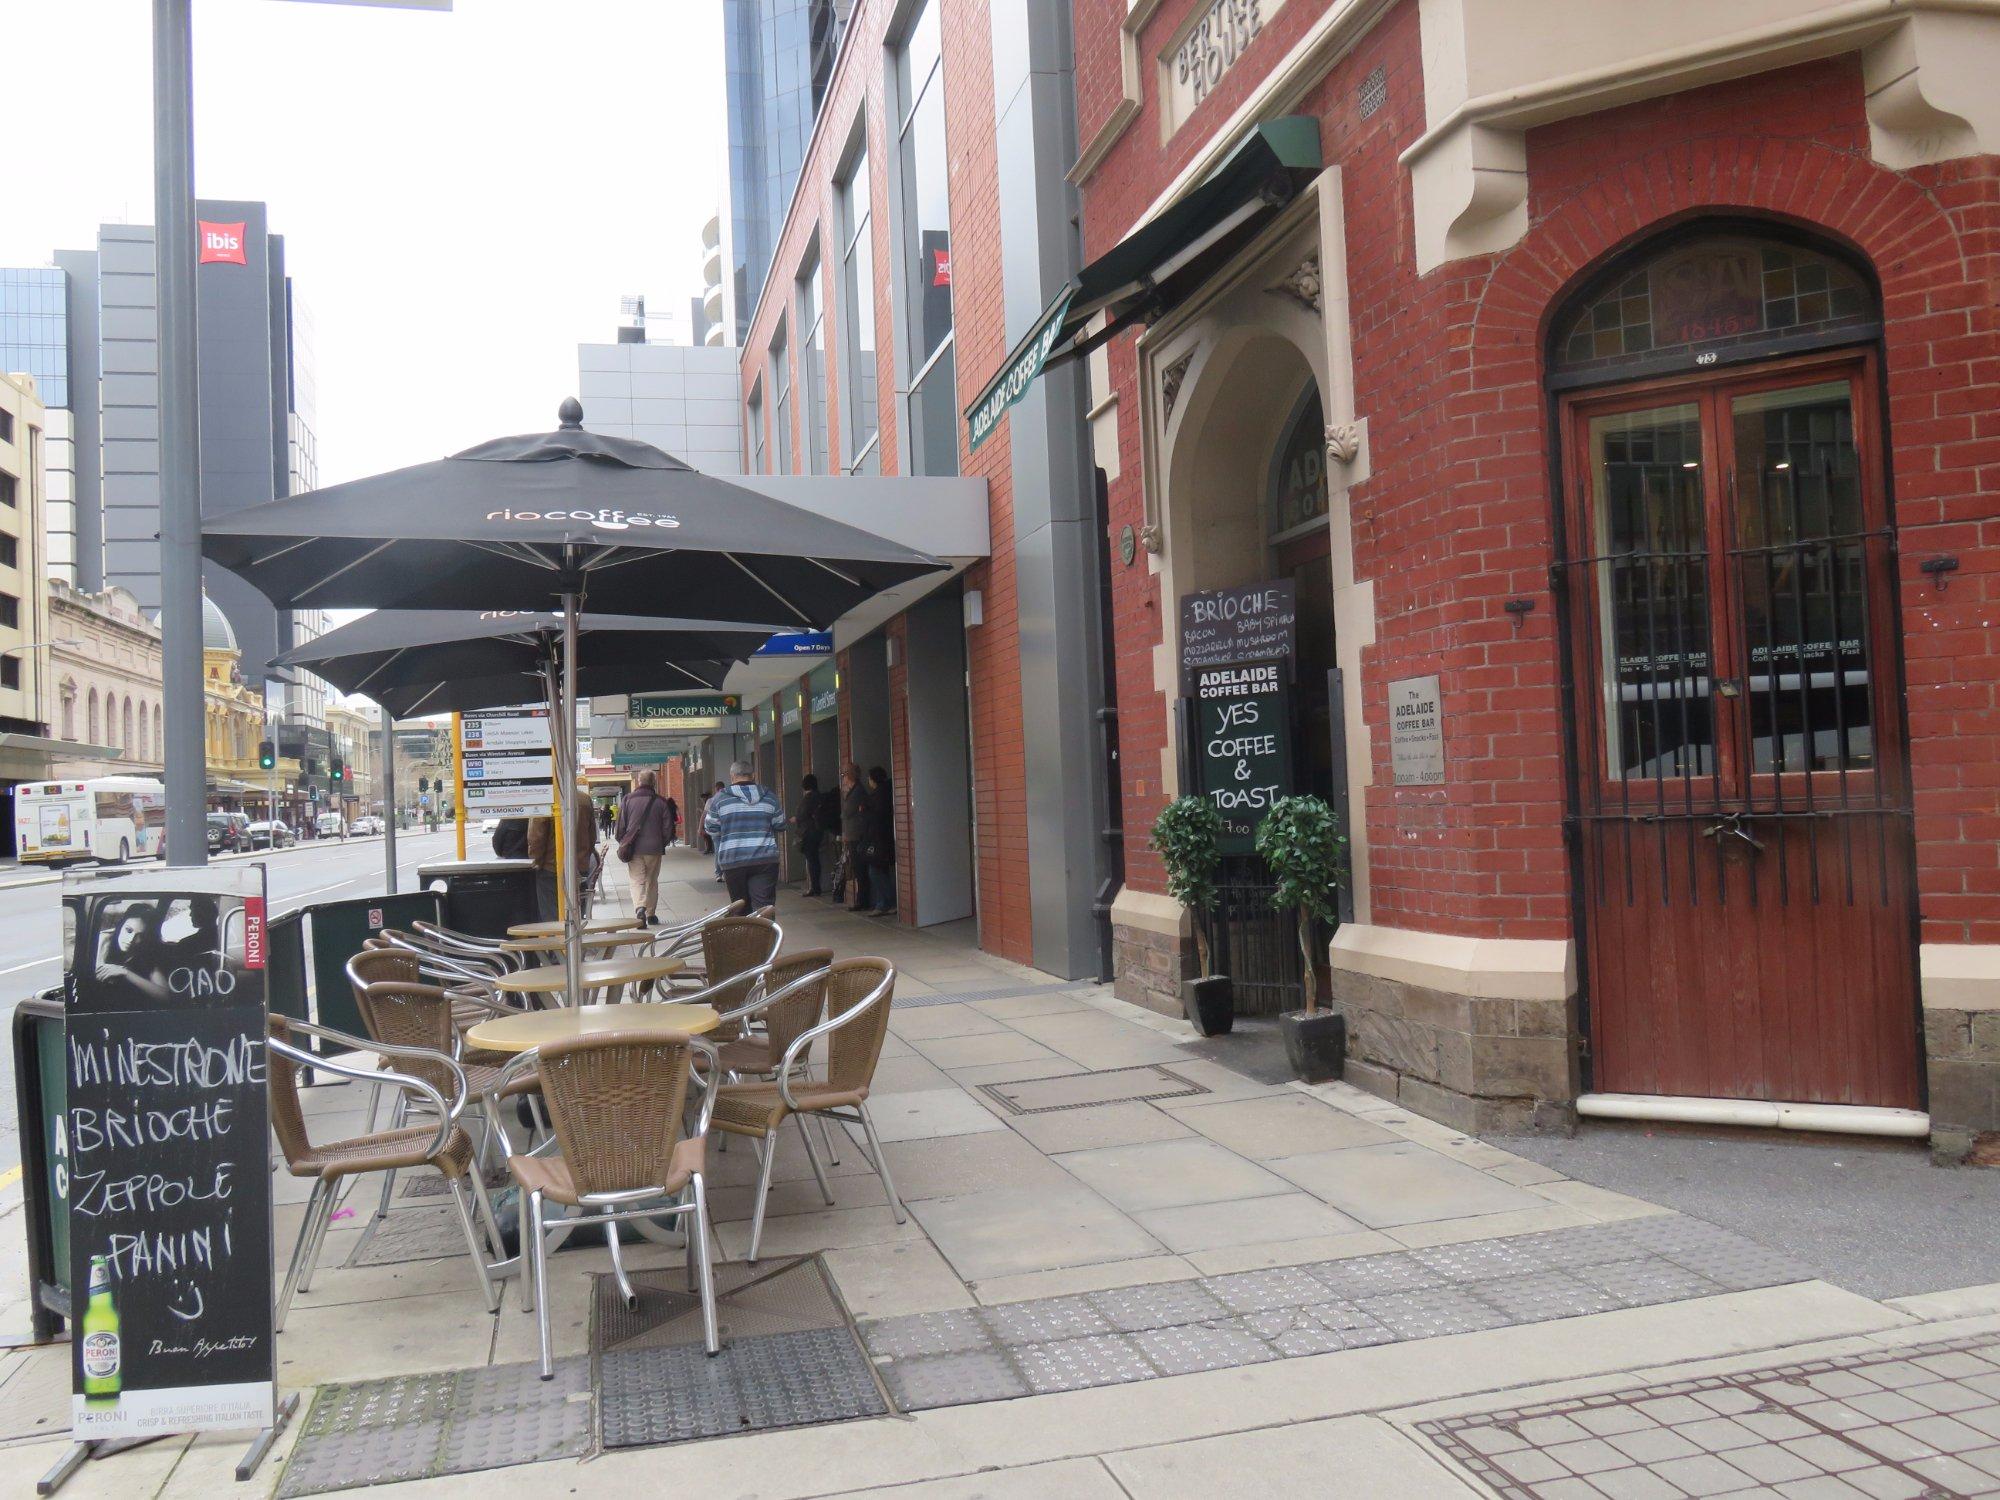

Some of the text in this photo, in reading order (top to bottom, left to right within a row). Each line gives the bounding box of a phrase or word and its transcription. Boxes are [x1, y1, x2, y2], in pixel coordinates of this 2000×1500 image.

[1192, 0, 1263, 106] HOUSE
[207, 232, 239, 249] ibis
[972, 383, 1006, 442] ADELAIDE
[1006, 342, 1039, 402] COFFEE
[487, 508, 680, 529] riocoffee
[1839, 640, 1859, 649] BAR
[1689, 652, 1707, 660] BAR
[1200, 666, 1278, 687] ADELAIDE
[1200, 681, 1279, 698] COFFEE BAR
[1408, 691, 1419, 699] The
[631, 699, 641, 719] ATM
[646, 706, 729, 717] SUNCORP BANK
[1215, 701, 1259, 735] YES
[1396, 701, 1434, 717] ADELAIDE
[1397, 718, 1435, 730] COFFEE BAR
[1207, 734, 1276, 758] COFFEE
[1234, 758, 1251, 780] &
[1210, 785, 1279, 809] TOAST
[247, 916, 260, 963] PERONI
[71, 1028, 267, 1088] MINESTRONE
[72, 1099, 233, 1152] BRIOCHE
[74, 1162, 236, 1216] ZEPPOLE
[105, 1206, 232, 1280] PANINI
[86, 1347, 118, 1358] PERONI
[78, 1410, 128, 1425] PERONI
[137, 1409, 263, 1428] CRISP & REFRESHING ITALIAN TASTE
